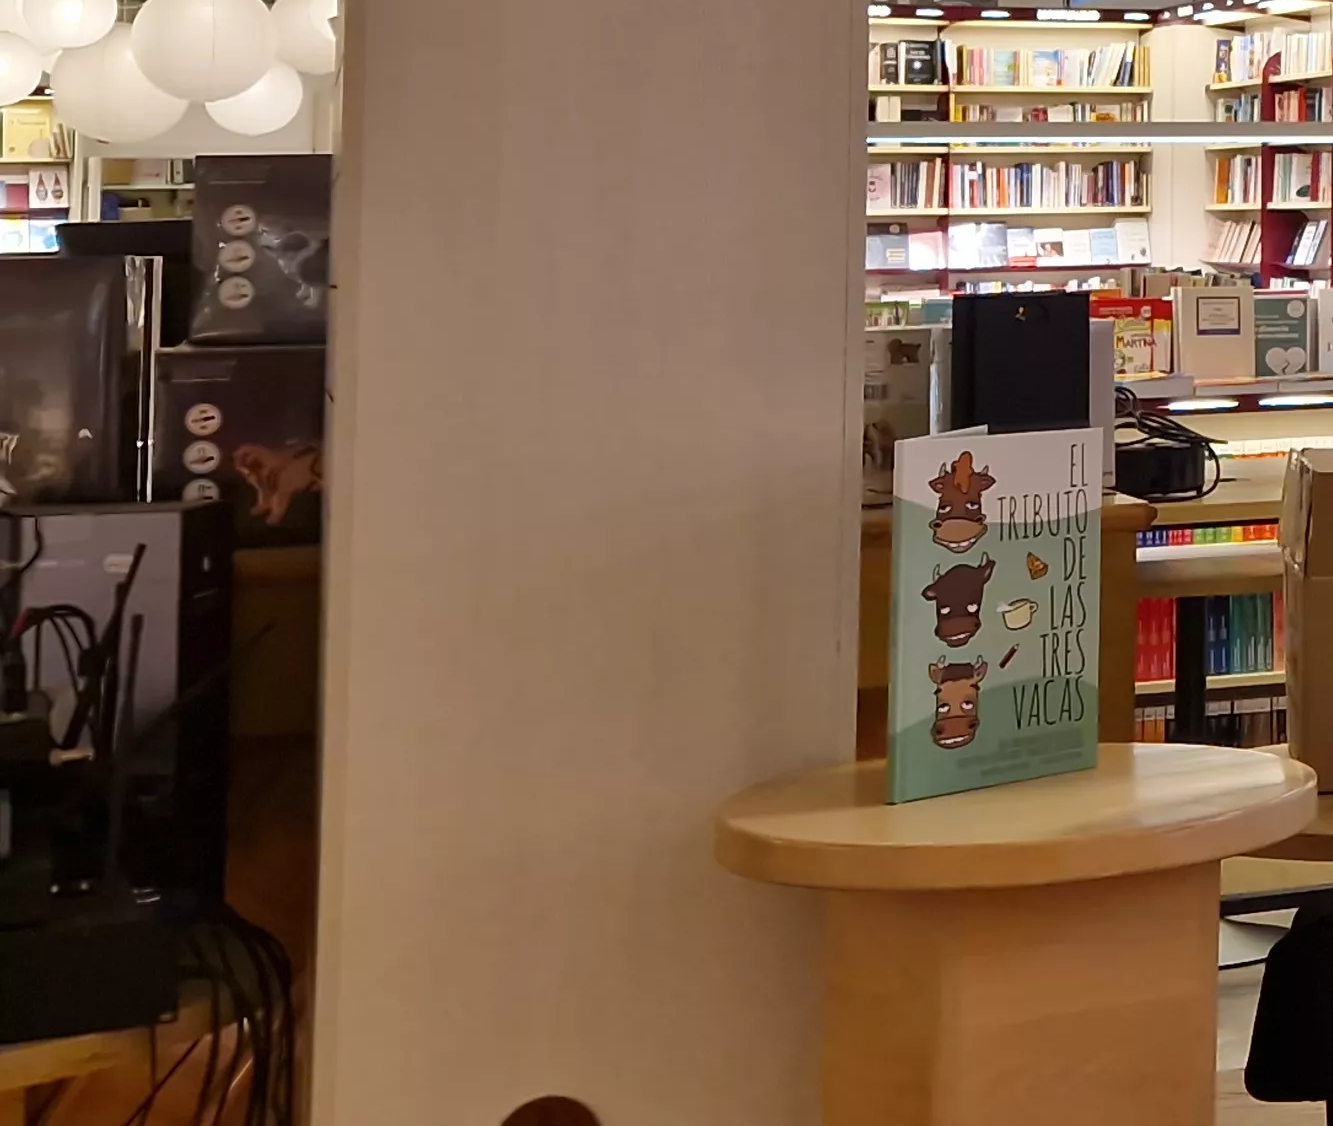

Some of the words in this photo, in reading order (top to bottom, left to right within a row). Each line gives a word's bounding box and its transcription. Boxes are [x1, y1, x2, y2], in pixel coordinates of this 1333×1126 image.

[1070, 442, 1089, 488] EL
[997, 488, 1088, 542] TRIBUTO
[1063, 535, 1087, 582] DE
[1050, 581, 1087, 630] LAS
[1039, 628, 1086, 678] TRES
[1012, 675, 1085, 730] VACAS
